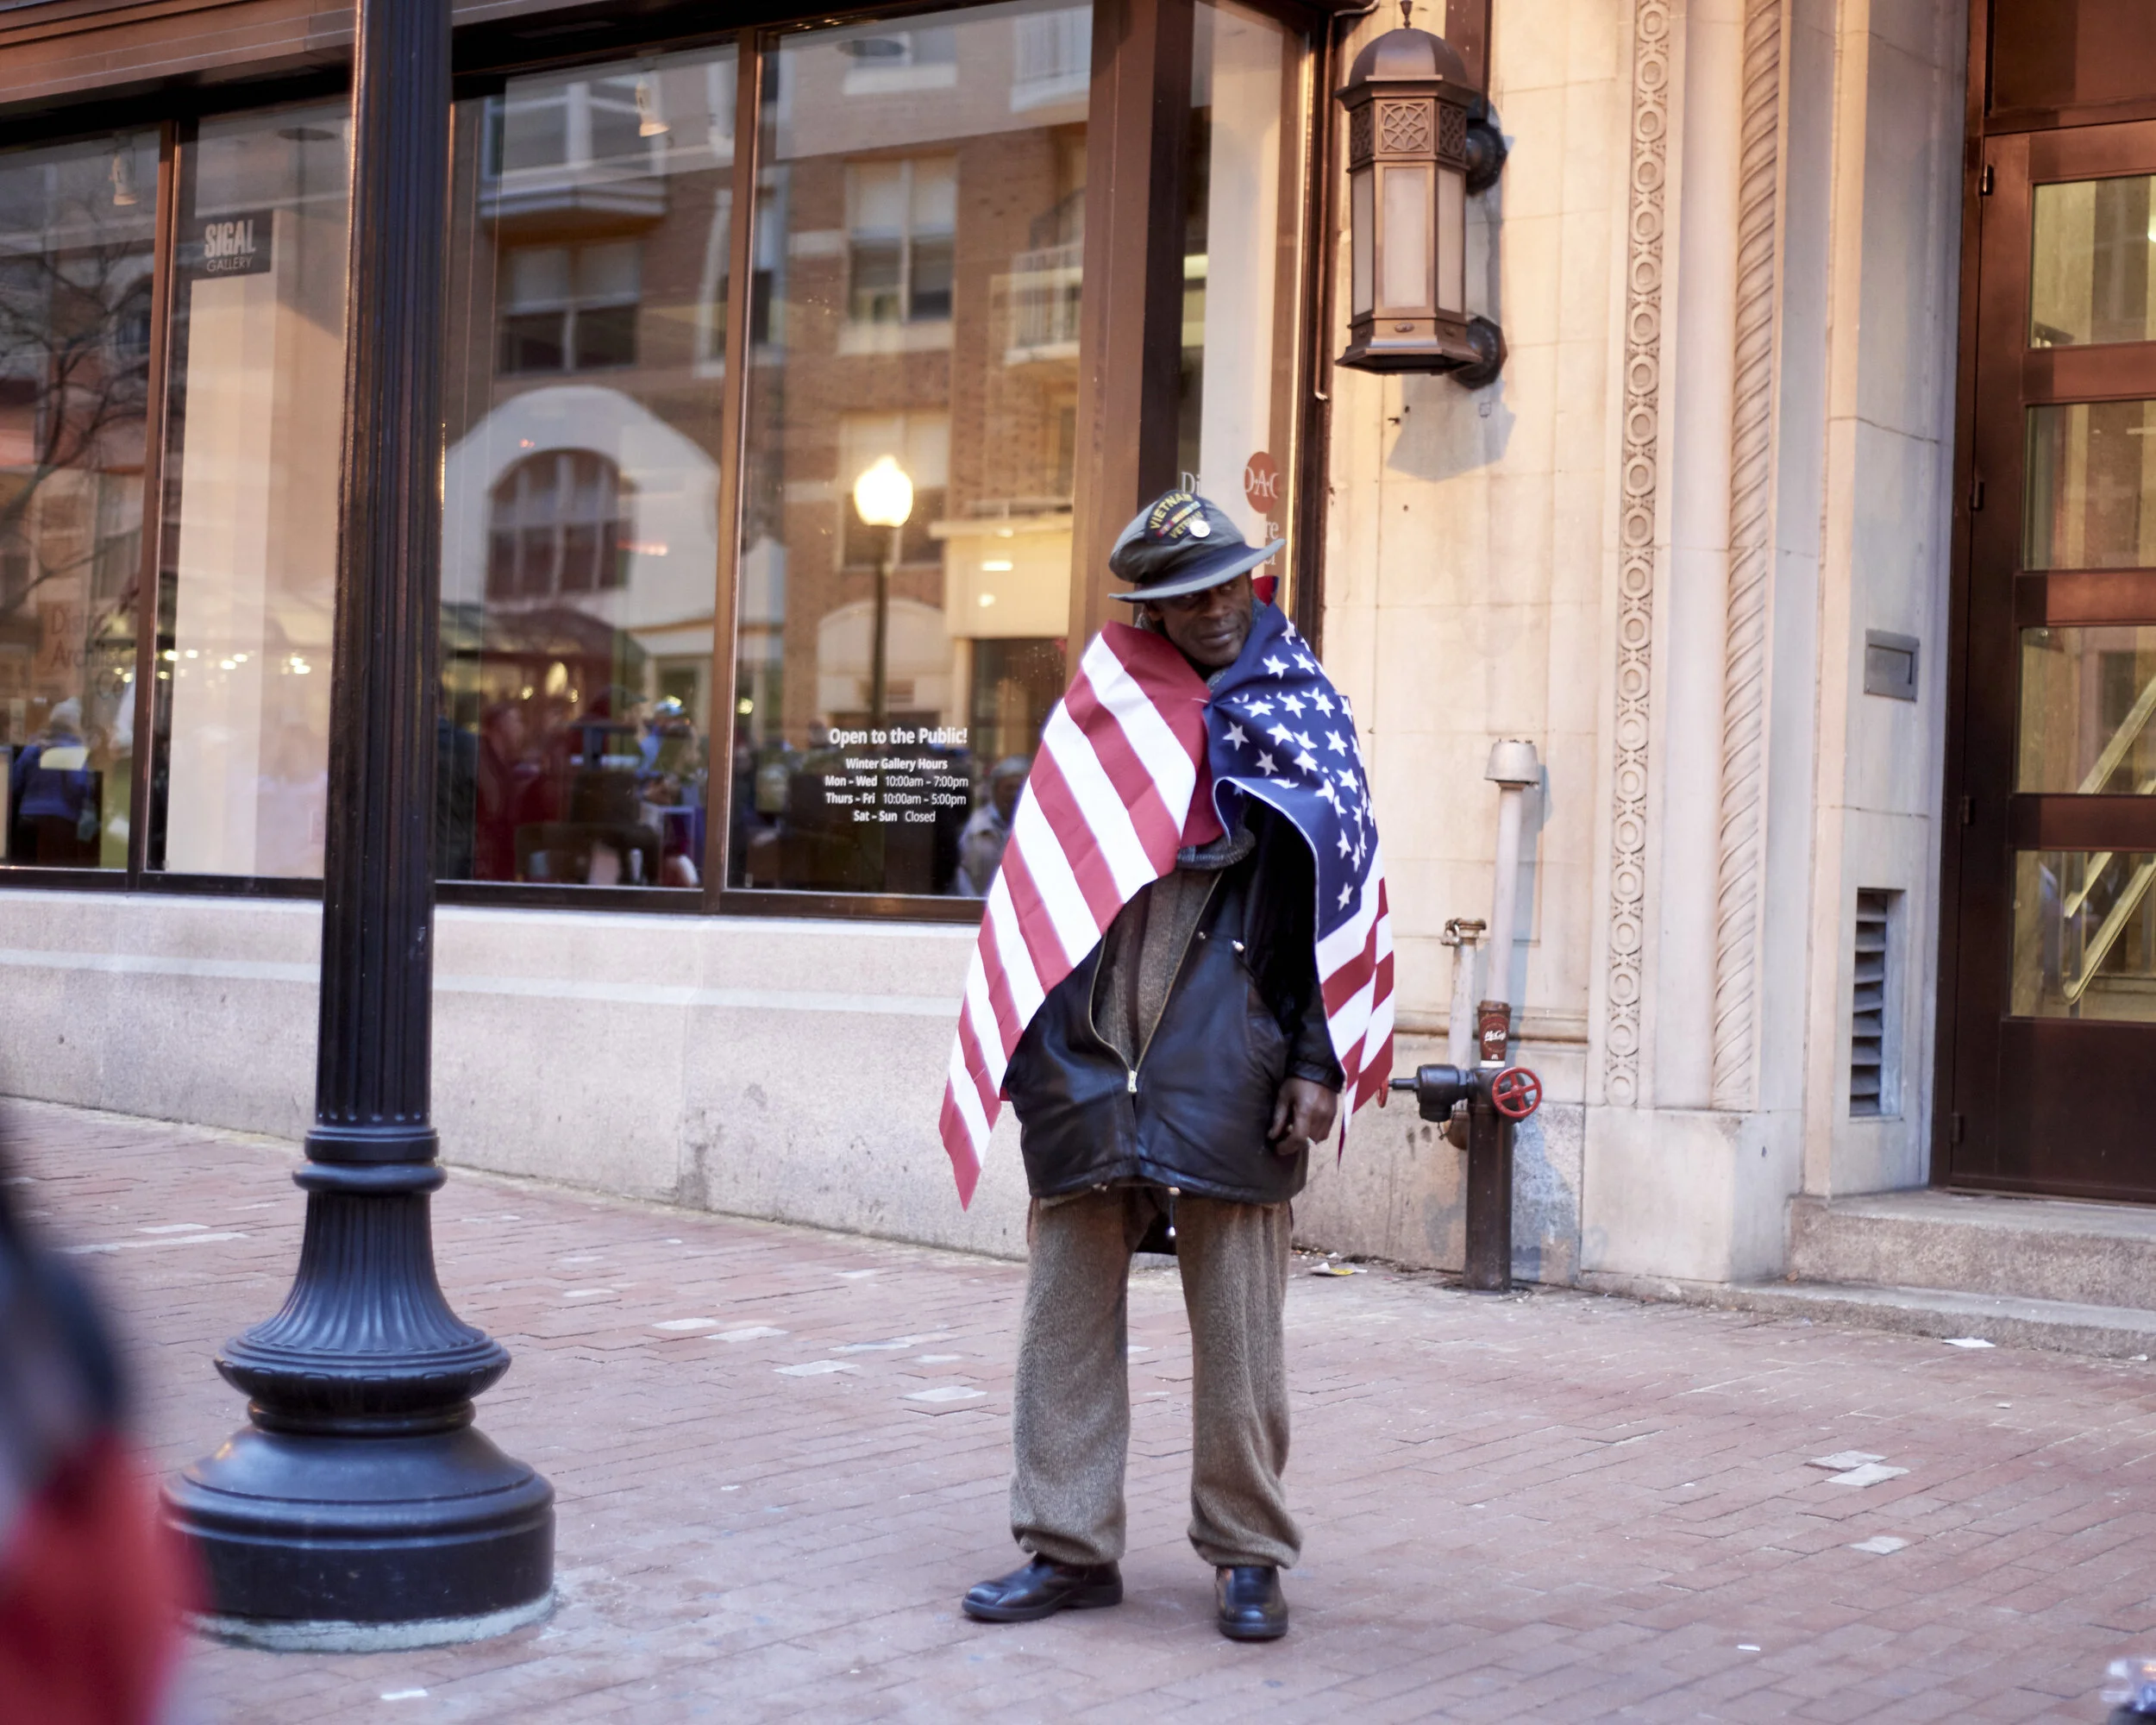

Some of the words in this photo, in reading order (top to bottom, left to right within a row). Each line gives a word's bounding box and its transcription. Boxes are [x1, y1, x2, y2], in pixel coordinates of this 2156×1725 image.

[204, 220, 256, 258] SIGAL
[207, 256, 252, 272] GALLERY
[1150, 492, 1194, 530] VIETNAM
[830, 728, 868, 749] Open
[871, 729, 887, 744] to
[890, 727, 915, 744] the
[919, 727, 968, 744] Public!
[845, 758, 880, 769] Winter
[881, 757, 916, 773] Gallery
[918, 758, 948, 769] Hours
[824, 775, 847, 787] Mon
[856, 775, 878, 787] Wed
[886, 775, 924, 787] 10:00am
[934, 776, 968, 790] 7:00pm
[826, 793, 854, 804] Thurs
[862, 793, 875, 804] Fri
[883, 794, 922, 805] 10:00am
[931, 794, 967, 808] 5:00pm
[854, 810, 870, 822] Sat
[879, 811, 898, 822] Sun
[905, 811, 936, 822] Closed
